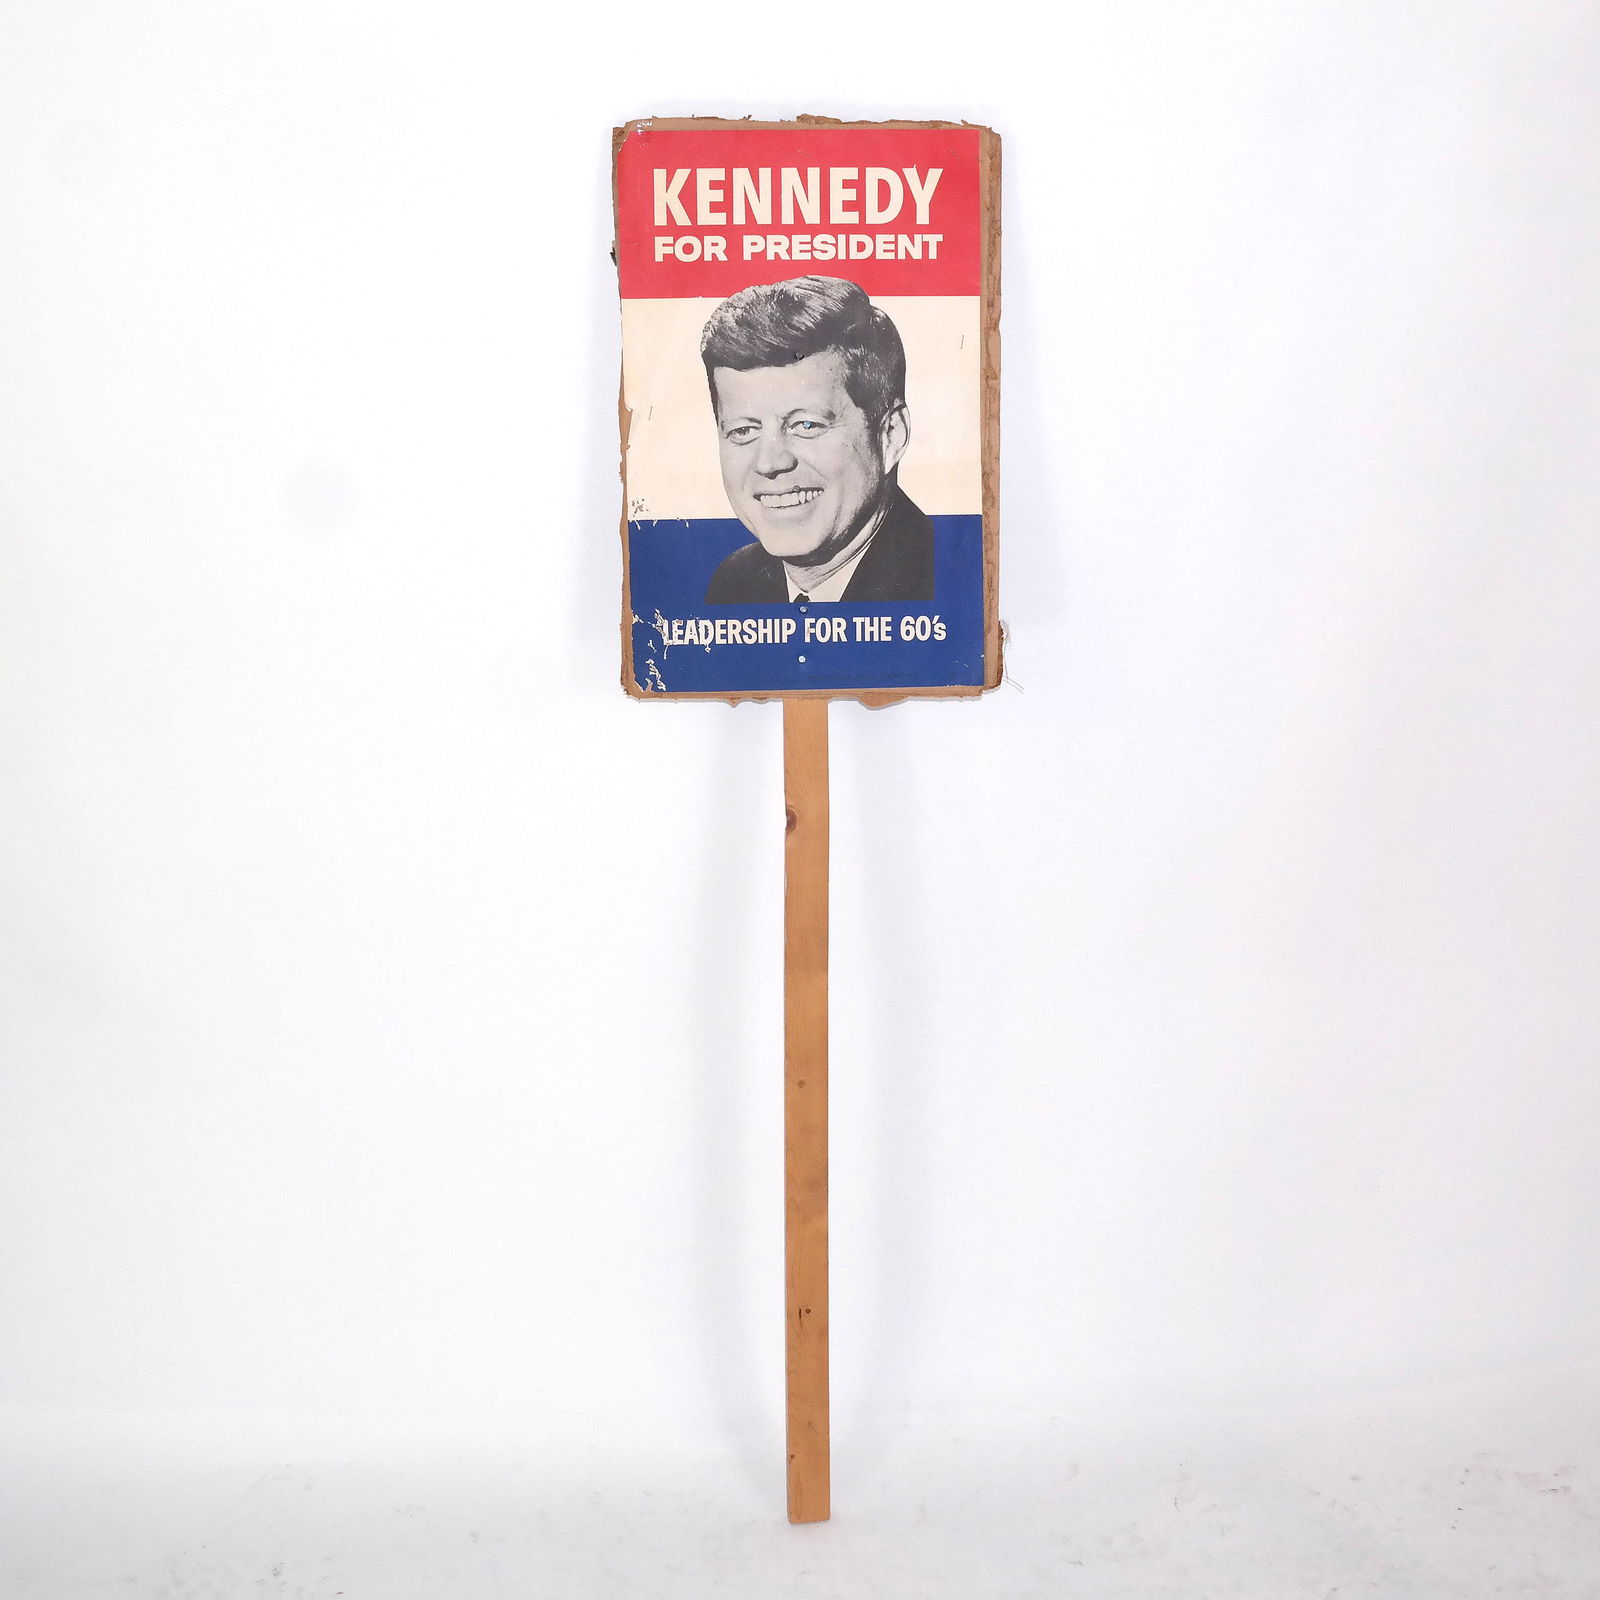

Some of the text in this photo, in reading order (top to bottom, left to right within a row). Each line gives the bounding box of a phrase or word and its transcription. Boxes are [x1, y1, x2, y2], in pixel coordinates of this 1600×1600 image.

[653, 167, 943, 226] KENNEDY
[654, 233, 943, 262] FOR PRESIDENT
[663, 615, 947, 645] LEADERSHIP FOR THE 60's
